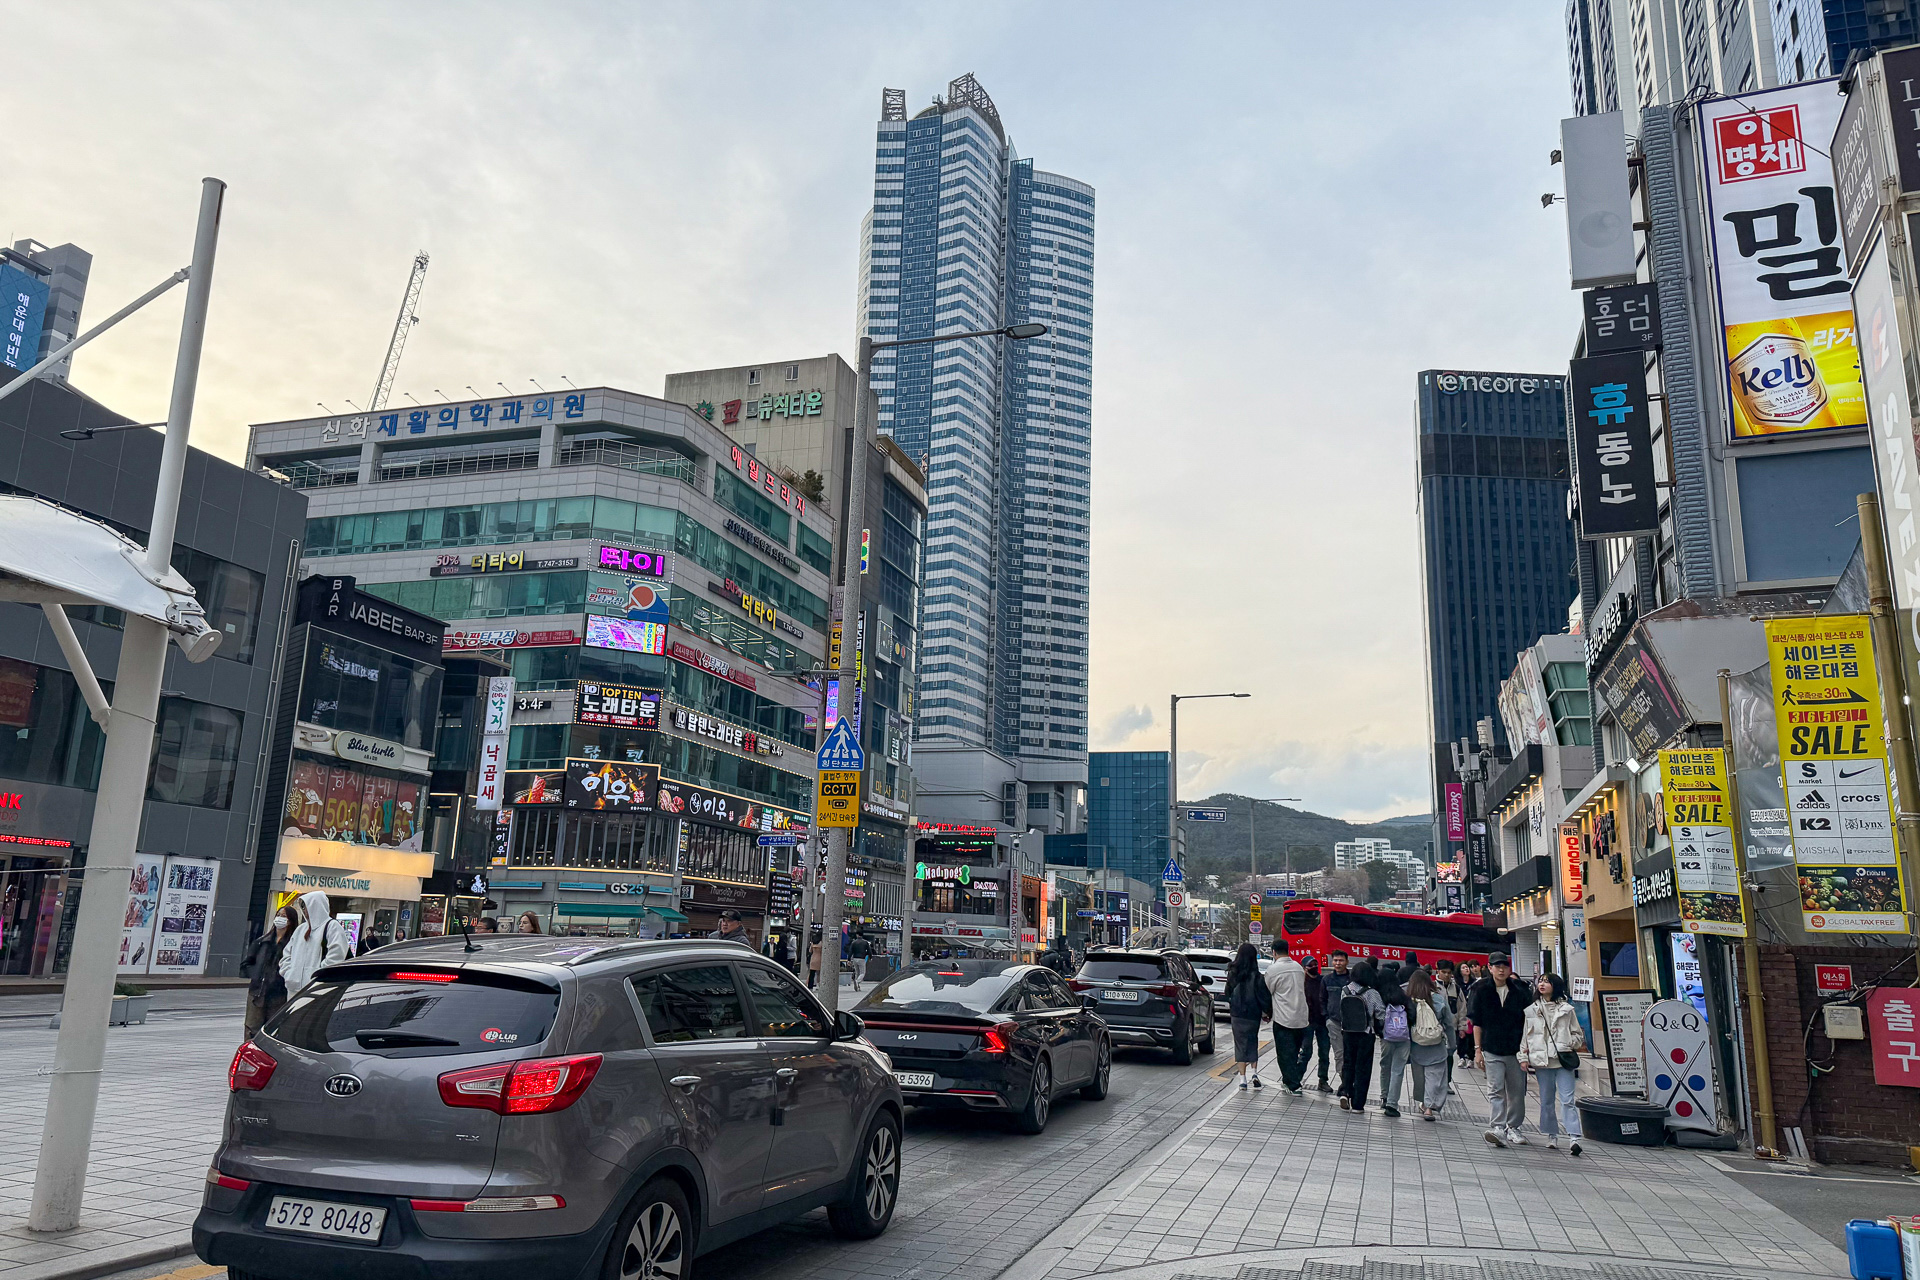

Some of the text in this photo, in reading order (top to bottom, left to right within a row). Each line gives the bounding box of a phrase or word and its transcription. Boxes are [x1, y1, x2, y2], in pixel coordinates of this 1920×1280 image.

[1737, 116, 1772, 143] 이
[1837, 106, 1865, 185] LIBERO
[1726, 139, 1798, 175] 명재
[1842, 145, 1868, 210] HOTEL
[1591, 294, 1651, 337] 홀덤
[1641, 333, 1654, 342] 3F
[1737, 353, 1816, 396] Kelly
[1441, 373, 1536, 395] encore
[758, 391, 823, 421] 뮤직타운
[321, 393, 586, 443] 신화재활의학과의원
[1588, 383, 1637, 505] 휴동노
[1882, 393, 1916, 557] SAVE
[470, 550, 525, 573] 더타이
[328, 579, 343, 616] BAR
[741, 594, 777, 631] 더타이
[404, 625, 438, 645] BAR 3F
[1849, 630, 1864, 639] 쇼핑
[1783, 643, 1857, 662] 세이브존
[1785, 661, 1859, 681] 해운대점
[584, 684, 597, 694] 10
[601, 687, 642, 700] TOP TEN
[1824, 687, 1848, 699] 30m
[582, 694, 656, 719] 노래타운
[688, 712, 743, 747] 탑텐노래타운
[347, 737, 369, 752] Blue
[371, 742, 395, 759] turtle
[1790, 723, 1871, 756] SALE
[821, 760, 860, 769] 횡단보도
[1668, 753, 1715, 764] 세이브존
[482, 744, 500, 801] 낙곱새
[1669, 765, 1716, 776] 해운대점
[1802, 762, 1817, 777] S
[823, 784, 854, 795] CCTV
[0, 792, 24, 810] NK
[1796, 794, 1880, 810] adidas crocs
[818, 812, 838, 822] 24시간
[839, 812, 856, 823] 단속중
[1673, 804, 1724, 823] SALE
[1800, 818, 1831, 831] K2
[1859, 819, 1883, 830] Lynx
[1798, 846, 1839, 855] MISSHA
[1681, 862, 1701, 870] K2
[292, 873, 371, 891] PHOTO SIGNATURE
[610, 882, 645, 895] GS25
[973, 881, 999, 890] PASTA
[1171, 895, 1180, 903] 30
[1828, 918, 1860, 926] GLOBAL
[958, 928, 983, 937] PIZZA
[1823, 972, 1846, 982] 에스원
[1882, 999, 1920, 1073] 출구
[330, 1079, 356, 1093] KIA
[907, 1074, 931, 1086] 5396
[276, 1201, 373, 1235] 57오 8048
